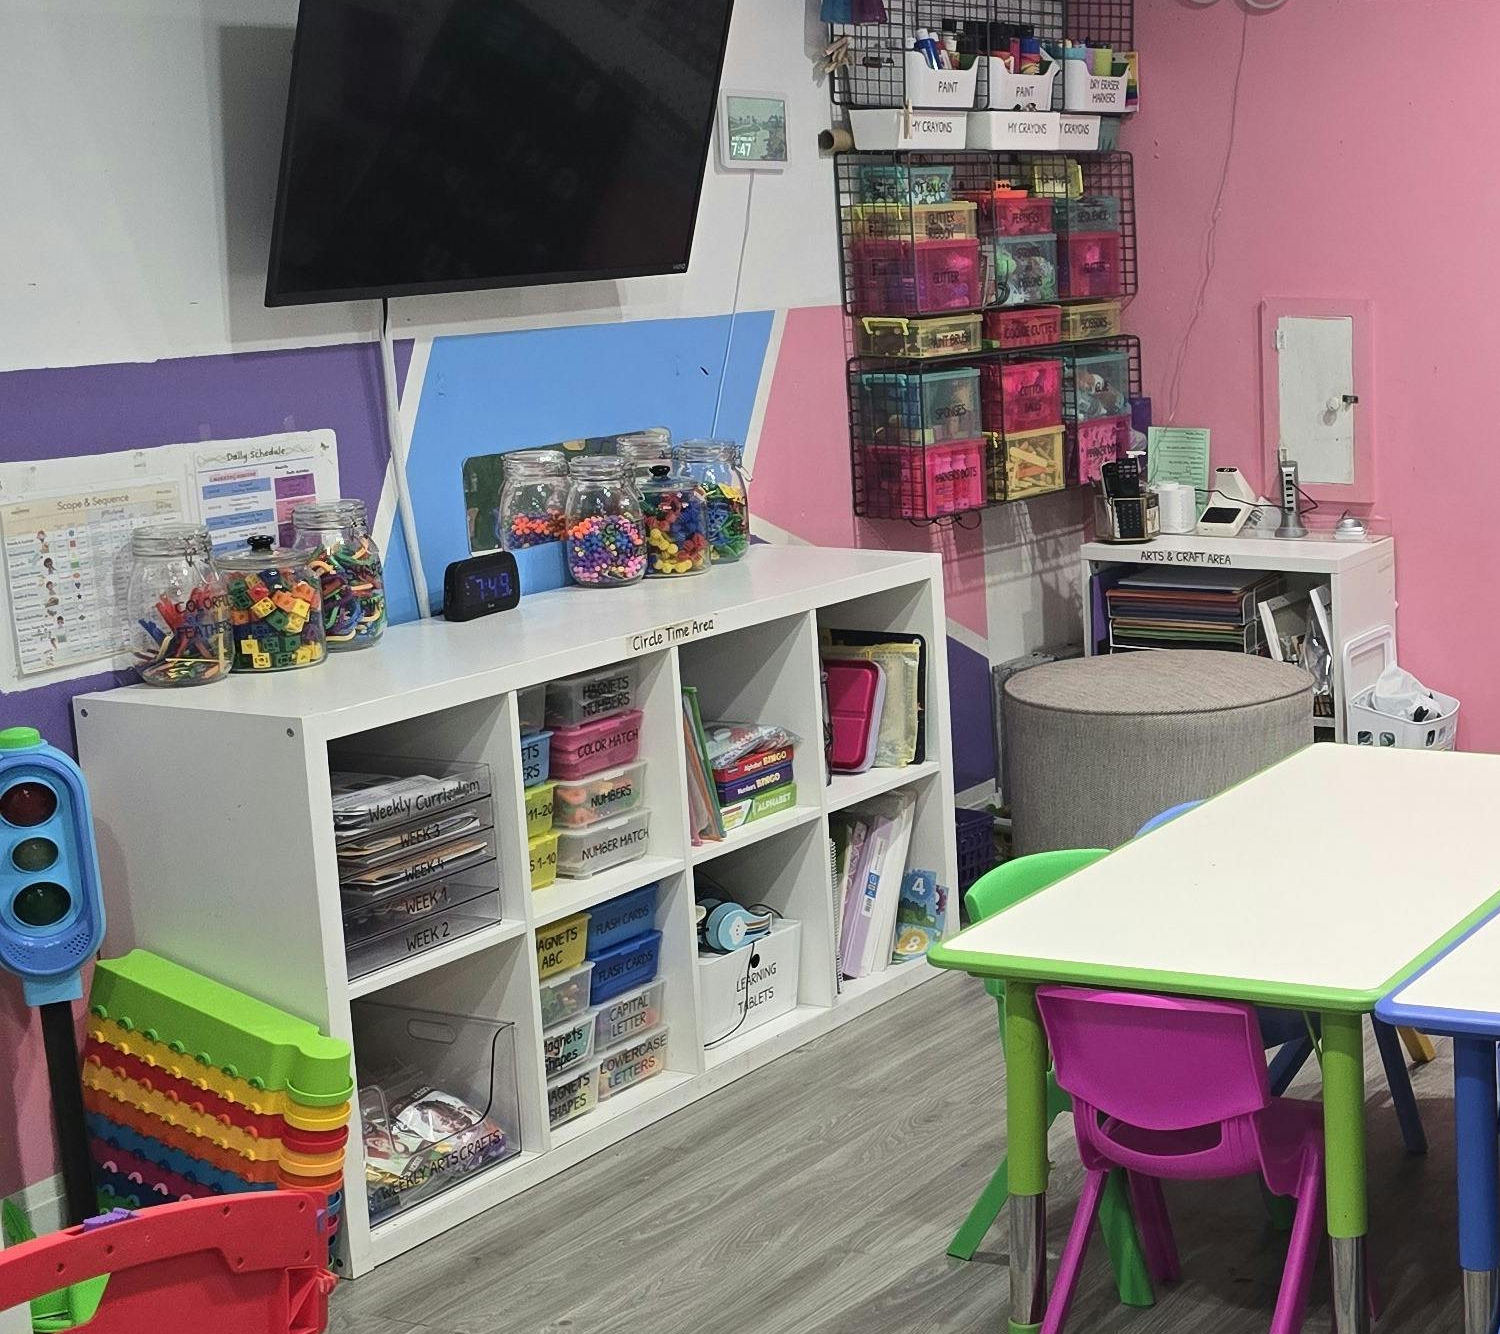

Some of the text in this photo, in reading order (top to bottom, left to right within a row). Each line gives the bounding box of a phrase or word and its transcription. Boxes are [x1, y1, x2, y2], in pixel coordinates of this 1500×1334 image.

[938, 81, 958, 94] PAINT
[1015, 85, 1035, 98] PAINT
[922, 121, 953, 134] CRAYONS
[1007, 122, 1017, 133] MY
[1018, 122, 1047, 134] CRAYONS
[1064, 123, 1090, 135] CRAYONS
[731, 142, 751, 156] 7:47
[226, 447, 286, 464] Daily Schedule
[57, 501, 82, 512] Scope
[84, 498, 91, 508] &
[92, 493, 129, 508] Sequence
[1141, 551, 1231, 565] ARTS & CRAFT AREA
[632, 618, 714, 652] Circle Time Area
[583, 692, 630, 717] NUMBERS
[577, 728, 639, 759] COLOR MATCH
[763, 751, 786, 765] BINGO
[756, 773, 780, 788] BINGO
[368, 780, 480, 823] Weekly Curriculum
[590, 784, 632, 808] NUMBERS
[758, 792, 791, 812] ALPHABET
[528, 803, 553, 821] 11-20
[400, 824, 441, 848] WEEK 3
[581, 827, 650, 862] NUMBER MATCH
[404, 860, 436, 882] WEEK
[911, 878, 925, 895] 4
[404, 887, 448, 914] WEEK 1
[595, 904, 649, 936] FLASH CARDS
[406, 921, 450, 952] WEEK 2
[906, 934, 920, 951] 8
[541, 950, 563, 970] ABC
[599, 951, 653, 983] FLASH CARDS
[736, 962, 777, 993] LEARNING
[609, 994, 649, 1022] CAPITAL
[737, 986, 774, 1015] TABLETS
[611, 1011, 646, 1037] LETTER
[600, 1033, 667, 1075] LOWERCASE
[608, 1055, 656, 1089] LETTERS
[382, 1129, 502, 1199] WEEKLY ARTS CRAFTS
